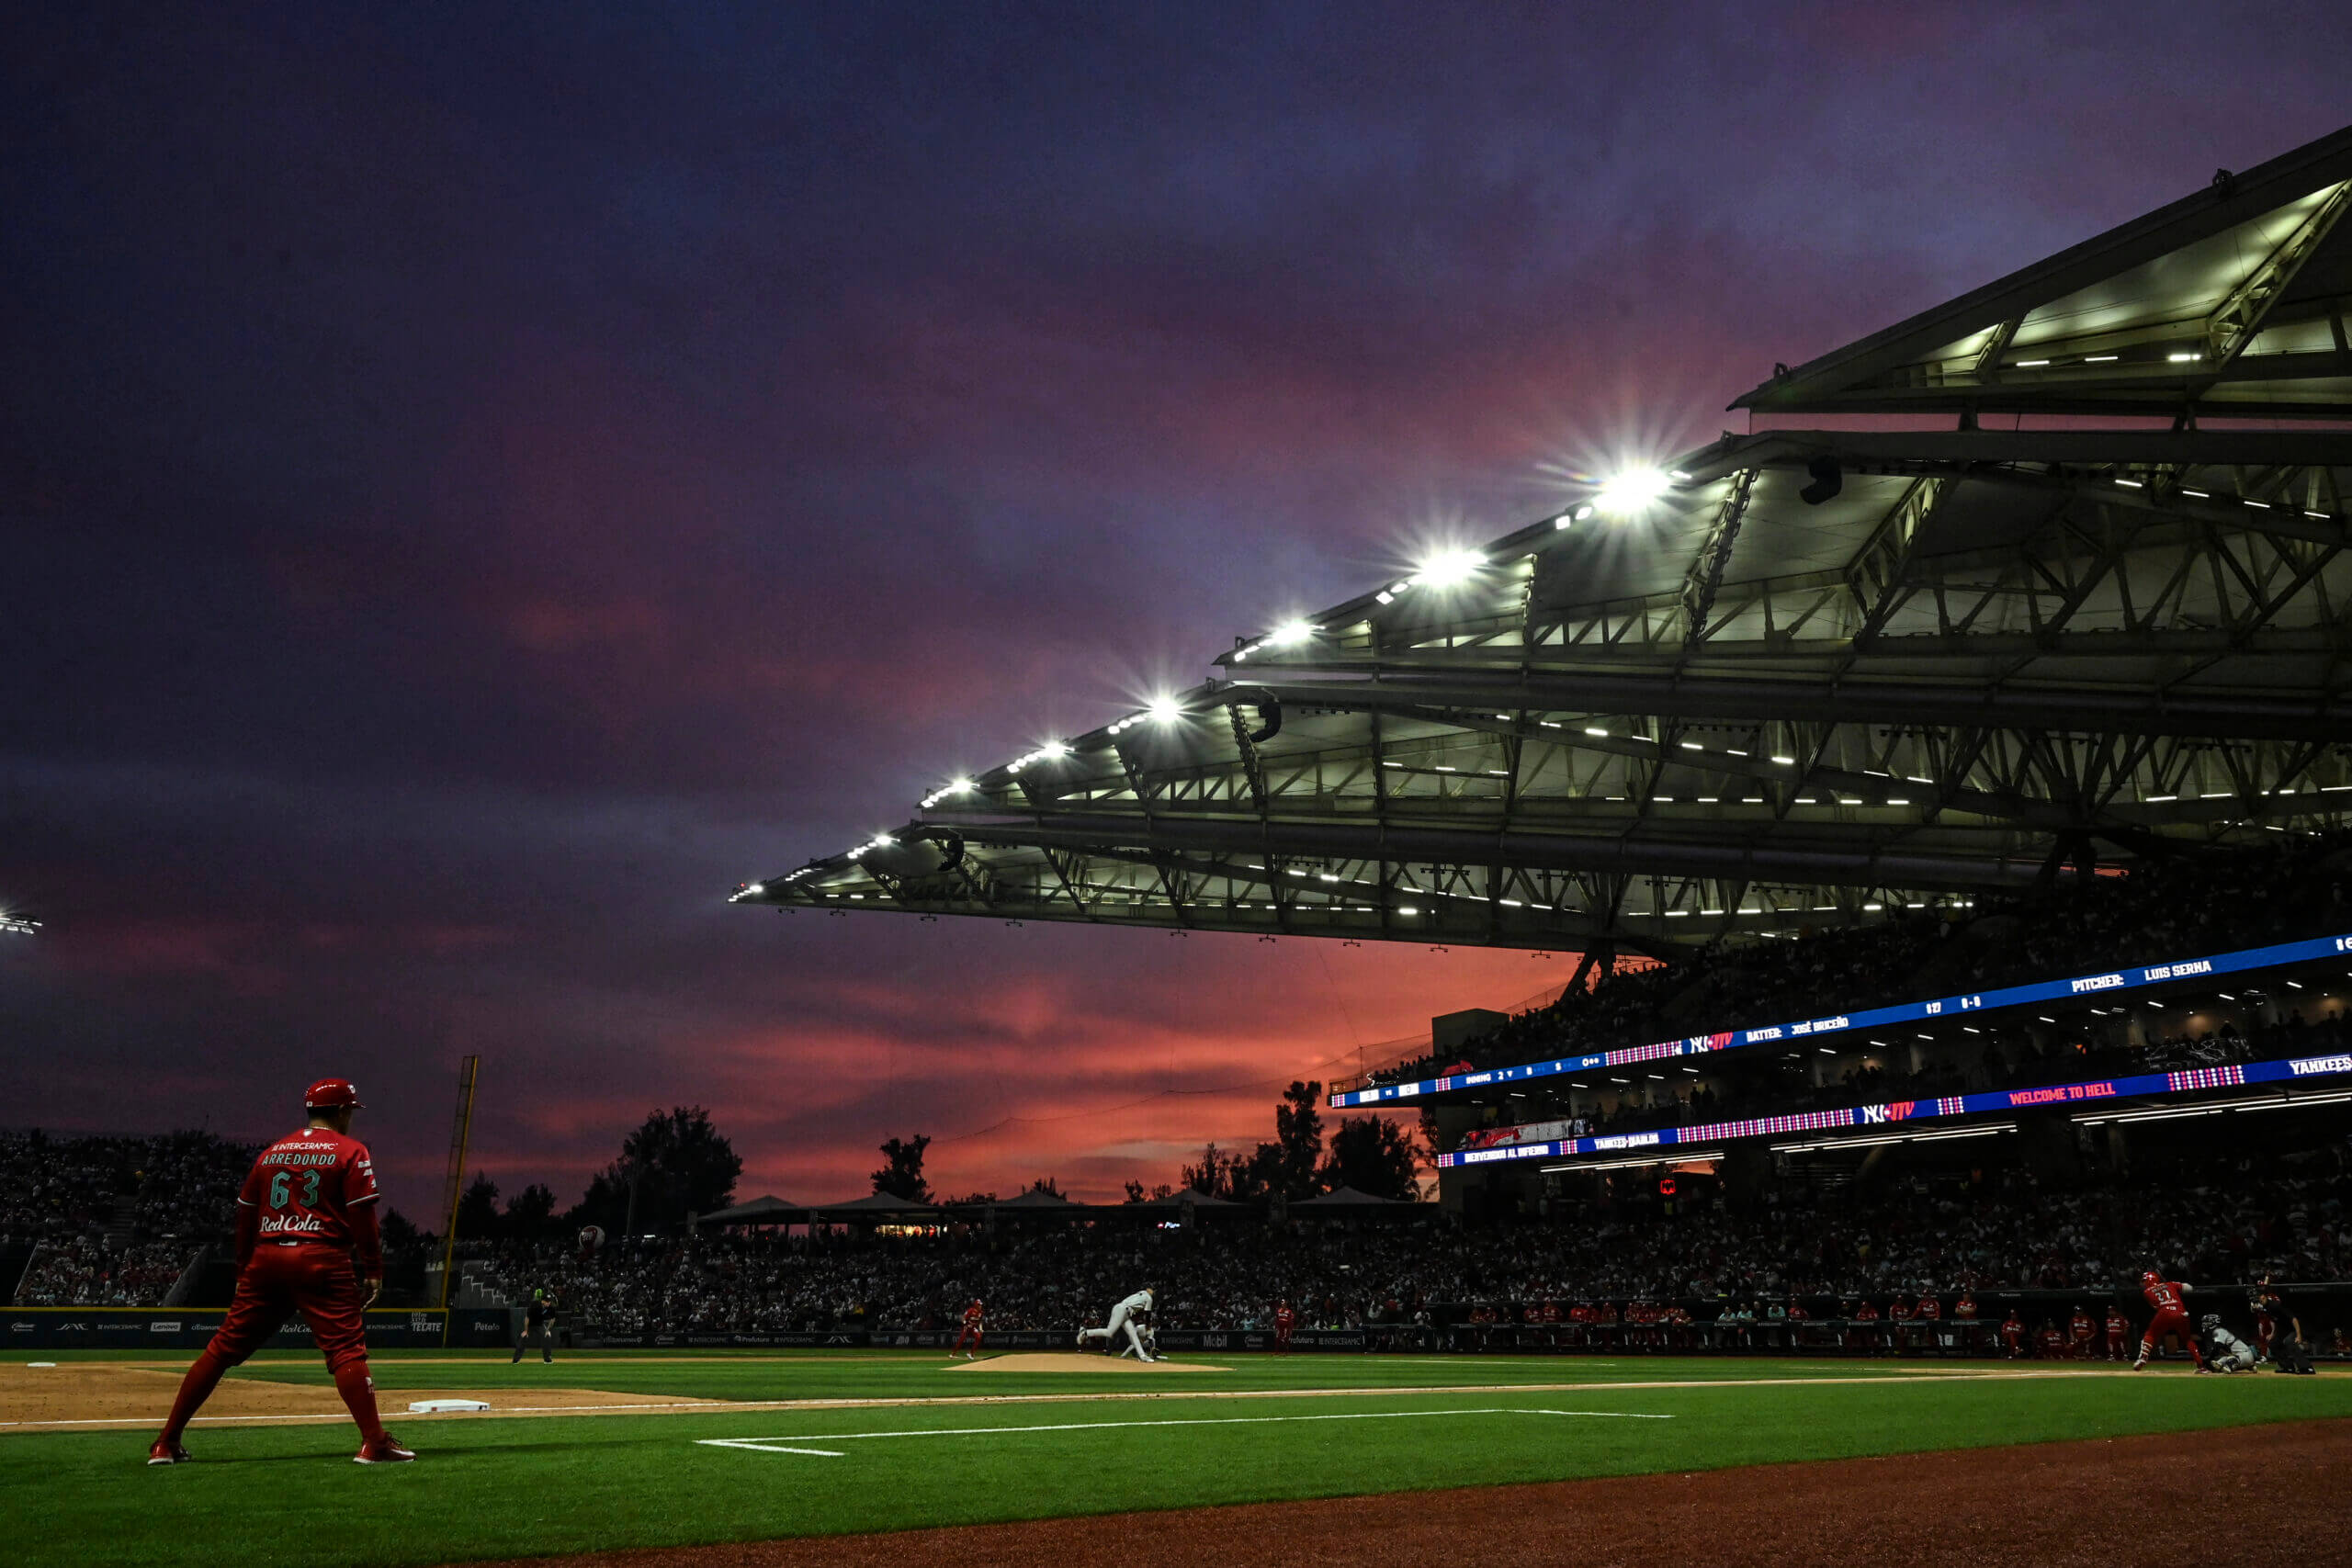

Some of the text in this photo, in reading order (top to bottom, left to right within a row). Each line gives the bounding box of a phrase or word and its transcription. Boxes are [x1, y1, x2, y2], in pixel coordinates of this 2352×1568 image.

[2072, 961, 2211, 992] PITCHER: LUIS SERNA
[1747, 1028, 1781, 1043] BATTER:
[1792, 1021, 1812, 1035] JOSÉ
[2289, 1055, 2352, 1075] YANKEES
[1498, 1071, 1504, 1080] 2
[2009, 1083, 2116, 1105] WELCOME TO HELL
[261, 1153, 336, 1166] ARREDONDO
[269, 1169, 320, 1210] 63
[412, 1323, 443, 1332] TECATE
[1203, 1335, 1227, 1348] Mobil
